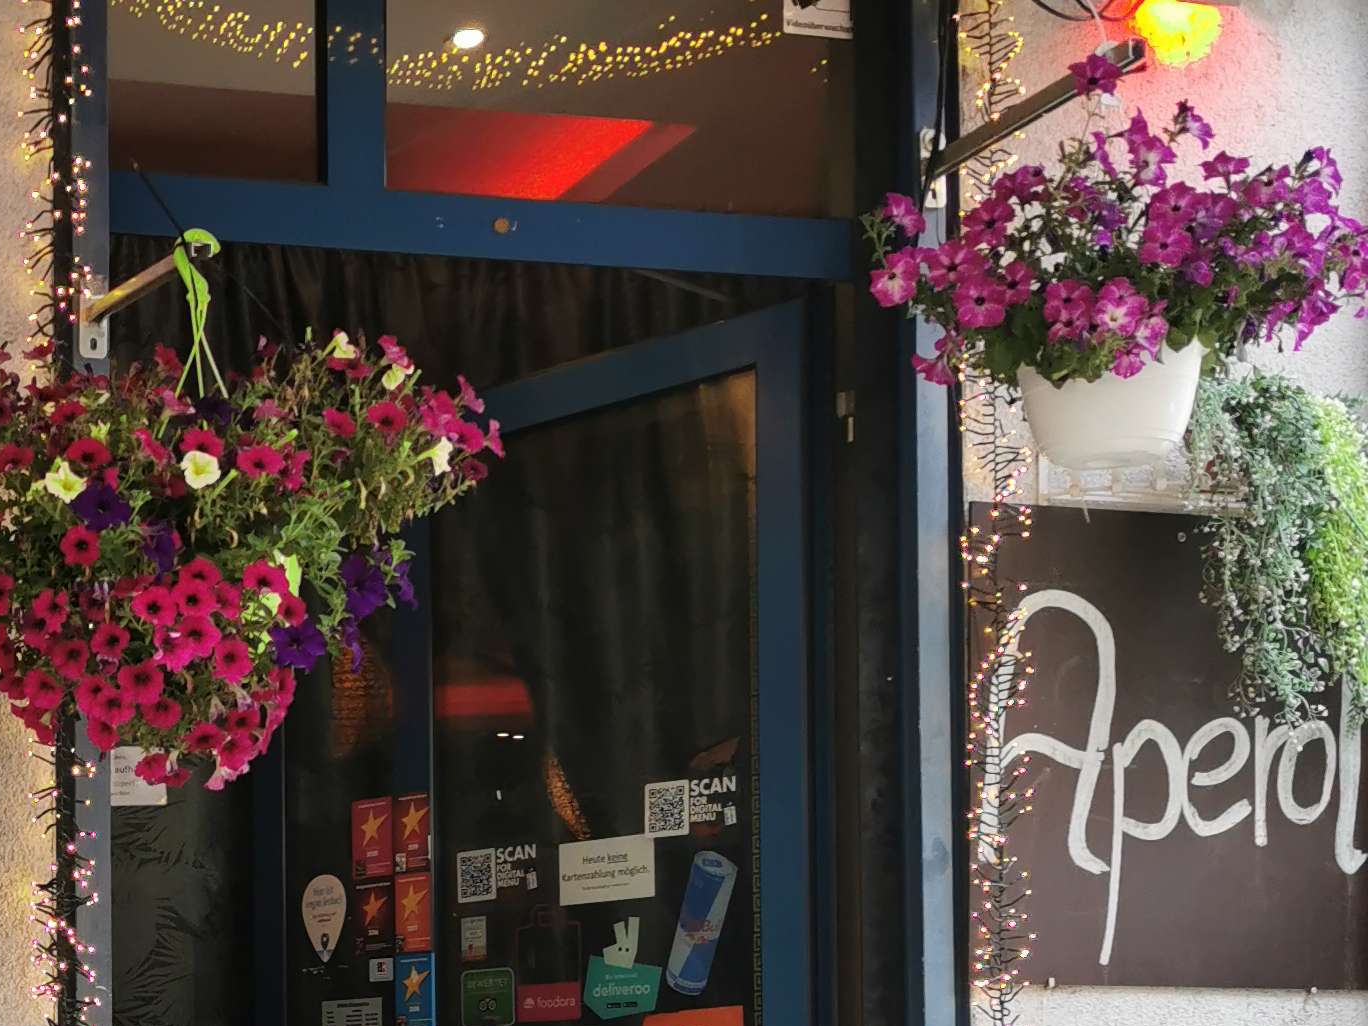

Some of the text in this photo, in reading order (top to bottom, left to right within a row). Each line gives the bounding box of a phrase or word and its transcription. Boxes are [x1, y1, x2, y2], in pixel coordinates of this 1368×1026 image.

[978, 588, 1367, 966] Aperol
[689, 775, 737, 797] SCAN
[690, 796, 708, 806] FOR
[690, 803, 723, 814] DIGITAL
[690, 812, 717, 823] MENU
[496, 843, 537, 864] SCAN
[582, 851, 629, 865] Heute keine
[497, 862, 512, 873] FOR
[497, 869, 525, 880] DIGITAL
[561, 869, 617, 882] Kartenzahlung
[497, 878, 520, 888] MENU
[592, 983, 651, 998] deliveroo
[536, 993, 576, 1009] foodora
